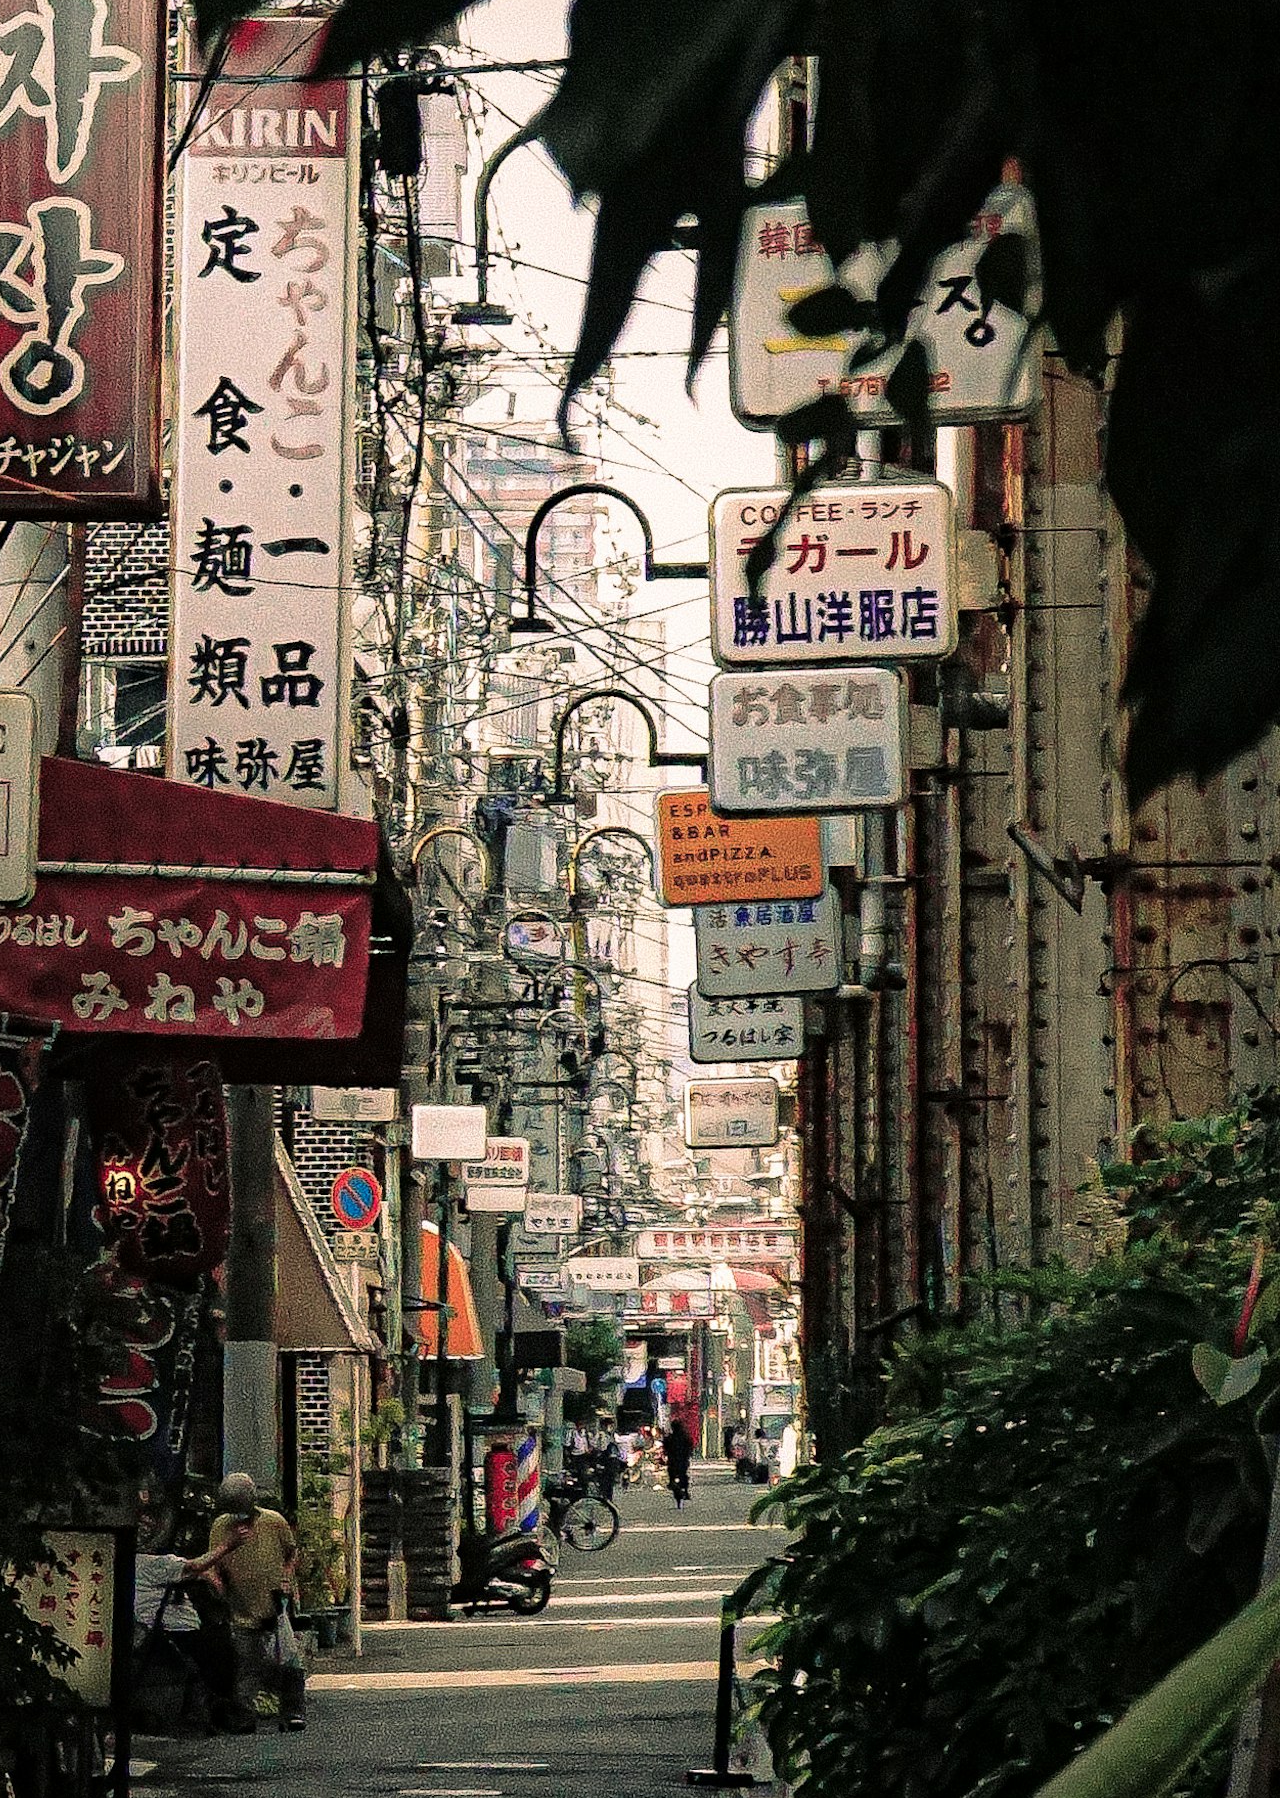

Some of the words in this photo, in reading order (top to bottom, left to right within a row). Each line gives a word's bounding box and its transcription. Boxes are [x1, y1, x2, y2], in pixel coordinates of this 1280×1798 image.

[197, 108, 339, 148] KIRIN
[212, 162, 321, 185] キリンビール
[733, 586, 938, 646] 勝山洋服店
[185, 737, 327, 792] 味弥屋
[107, 906, 346, 969] ちゃんこ鍋
[71, 970, 266, 1026] みねや
